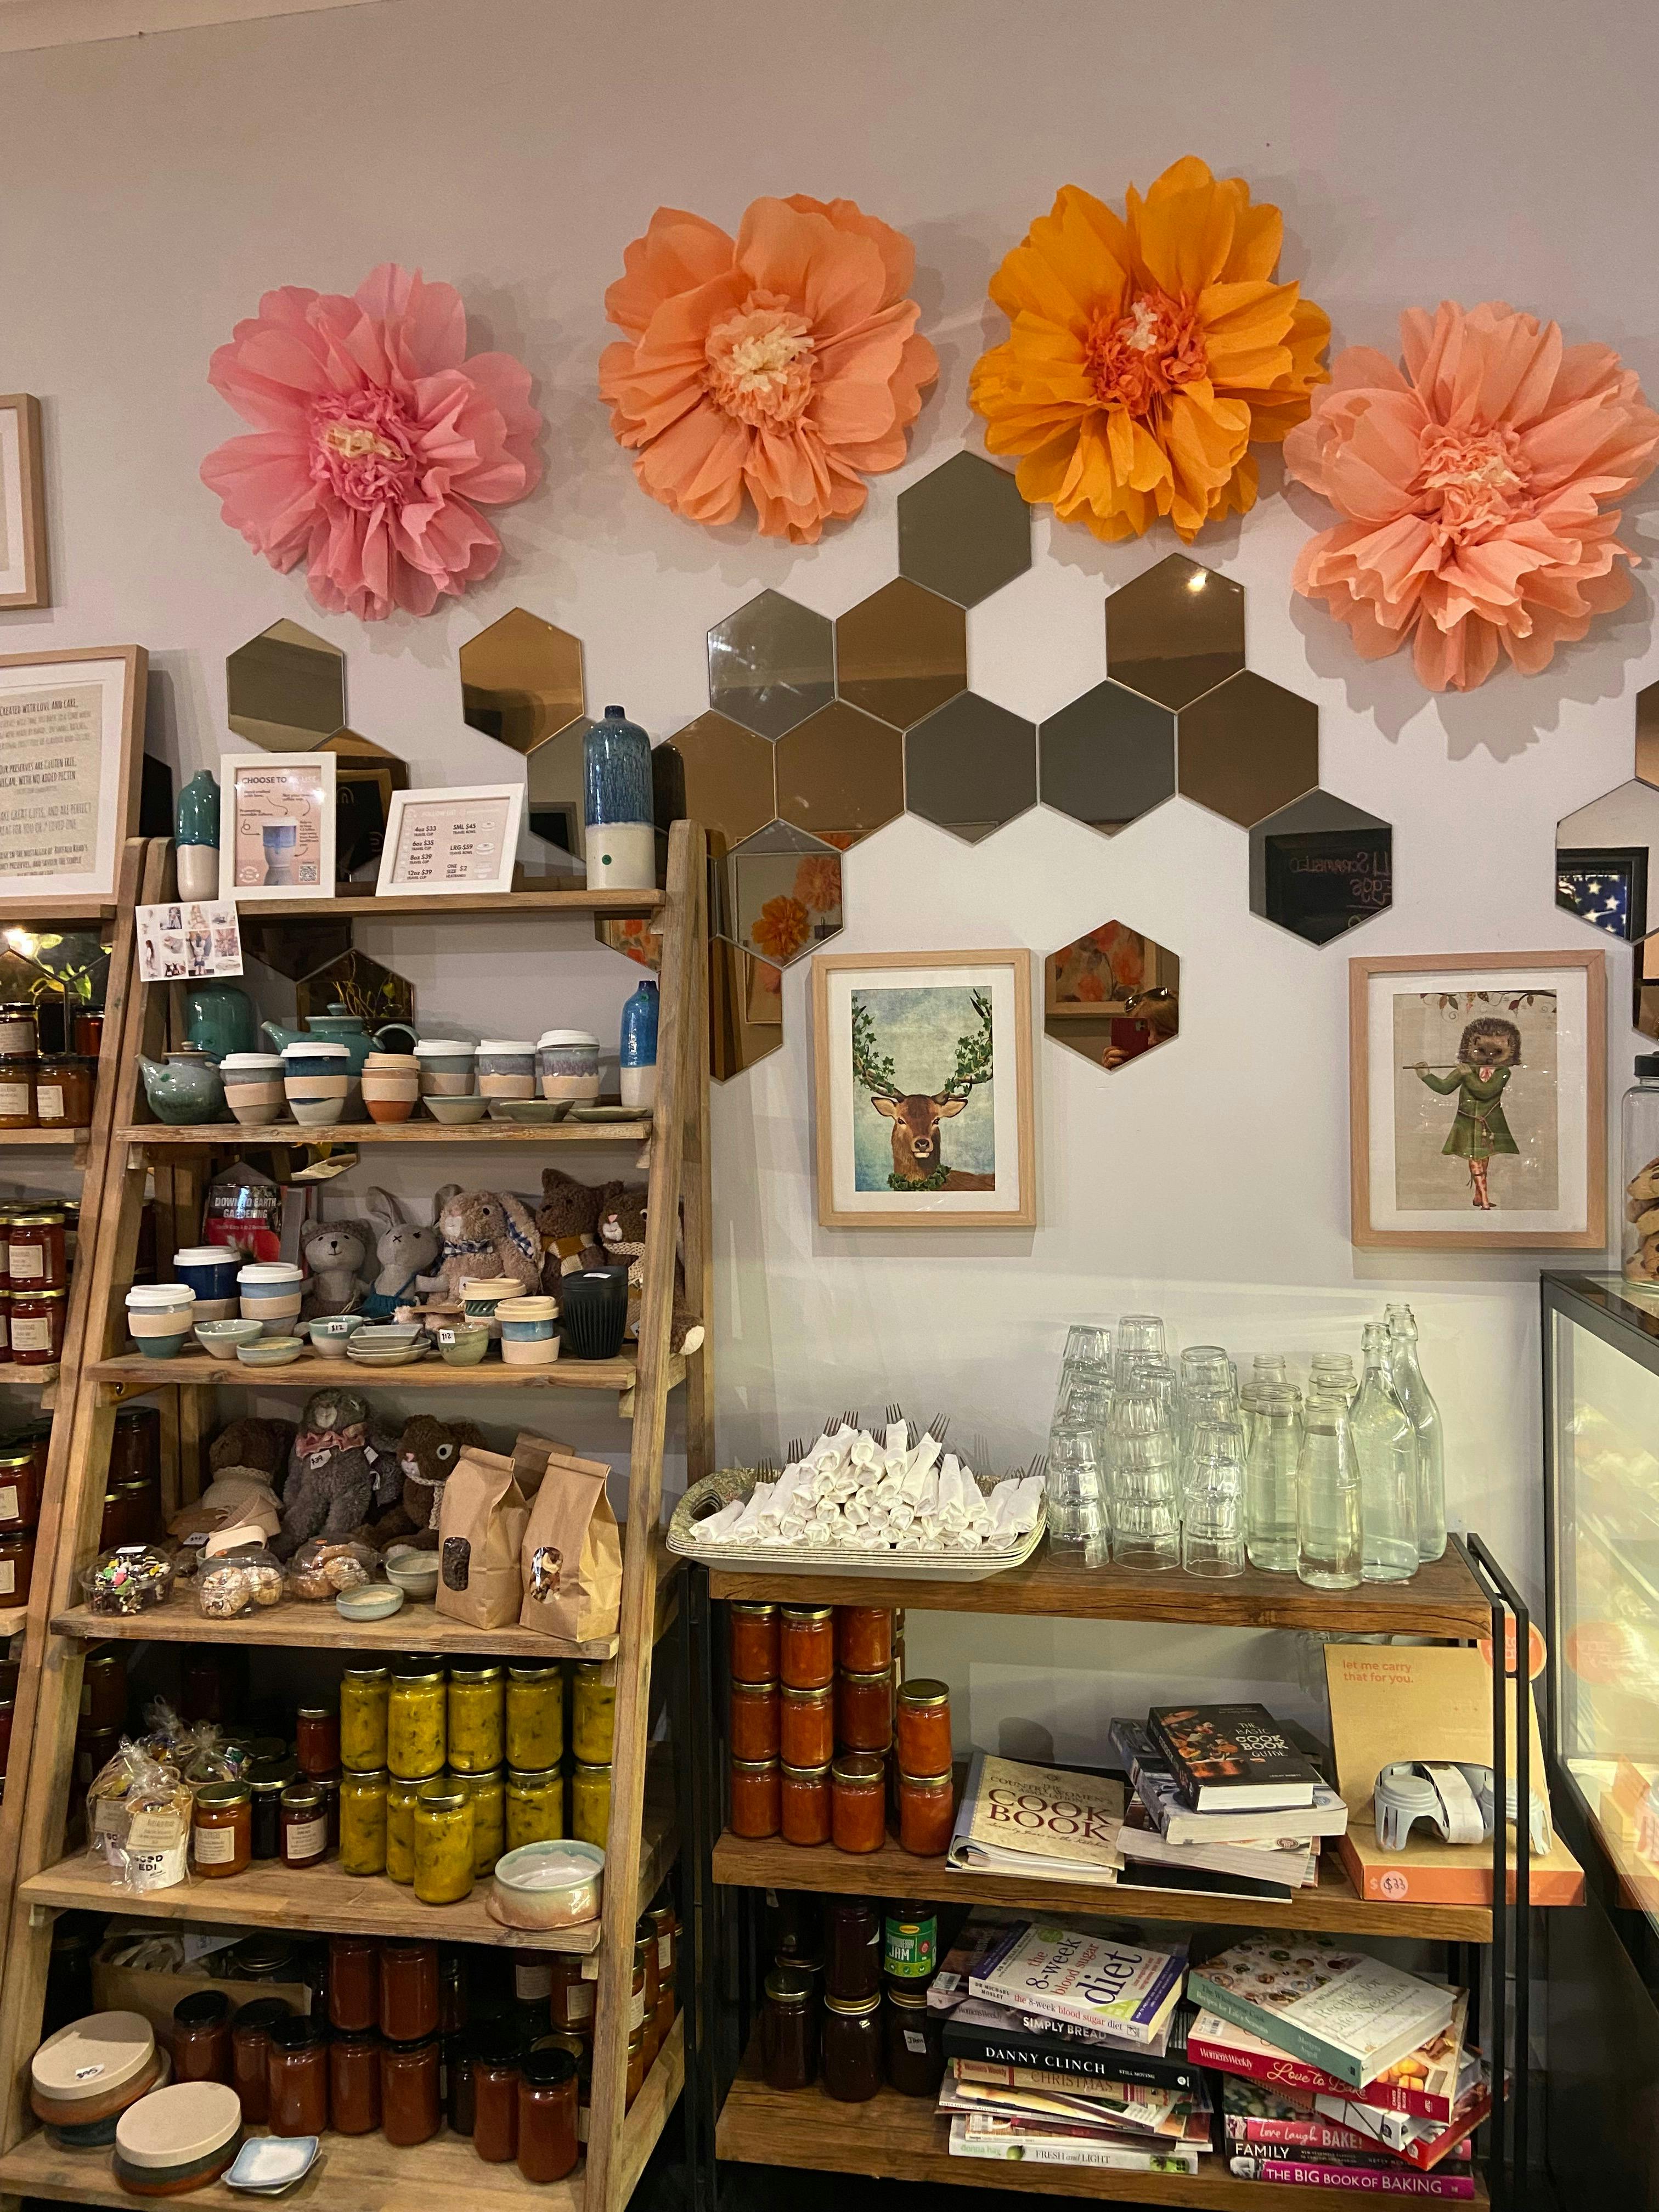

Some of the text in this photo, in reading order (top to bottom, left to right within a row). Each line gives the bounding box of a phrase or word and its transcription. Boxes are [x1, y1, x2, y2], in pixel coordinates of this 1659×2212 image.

[22, 703, 36, 713] WITH
[37, 702, 49, 712] LOVE
[52, 700, 62, 709] AND
[19, 775, 31, 785] WITH
[42, 772, 57, 783] ADDED
[253, 1198, 276, 1207] EARTH
[1342, 1659, 1357, 1669] let
[1383, 1663, 1412, 1673] carry
[1343, 1672, 1414, 1685] that for you.
[1235, 1735, 1285, 1743] COOK
[1240, 1741, 1289, 1751] BOOK
[990, 1776, 1048, 1795] COUNTRY
[988, 1788, 1114, 1826] COOK
[986, 1803, 1111, 1842] BOOK
[889, 1945, 910, 1961] JAM
[1027, 1951, 1048, 1967] the
[1025, 1938, 1082, 1990] 8-week
[1050, 1943, 1100, 1996] blood sugar
[1075, 1950, 1143, 2005] diet
[981, 1989, 1003, 2000] MOSLEY
[984, 1984, 1011, 1995] MICHAEL
[1357, 1982, 1409, 2011] Seasons
[1313, 1989, 1364, 2019] Recipes
[1358, 1978, 1382, 1992] for
[1014, 1994, 1123, 2031] the 8-week blood sugar diet
[1023, 2016, 1107, 2040] SIMPLY BREAD
[985, 2046, 1106, 2074] DANNY CLINCH
[1031, 2070, 1114, 2092] CHRISTMAS
[1134, 2071, 1155, 2079] MOVING
[1267, 2062, 1368, 2100] Love to Bake
[1322, 2129, 1363, 2149] BAKE!
[960, 2143, 1001, 2157] donna hay
[1035, 2149, 1111, 2164] FRESH and LIGHT
[1235, 2143, 1290, 2159] FAMILY
[1266, 2168, 1442, 2194] THE BIG BOOK OF BAKING
